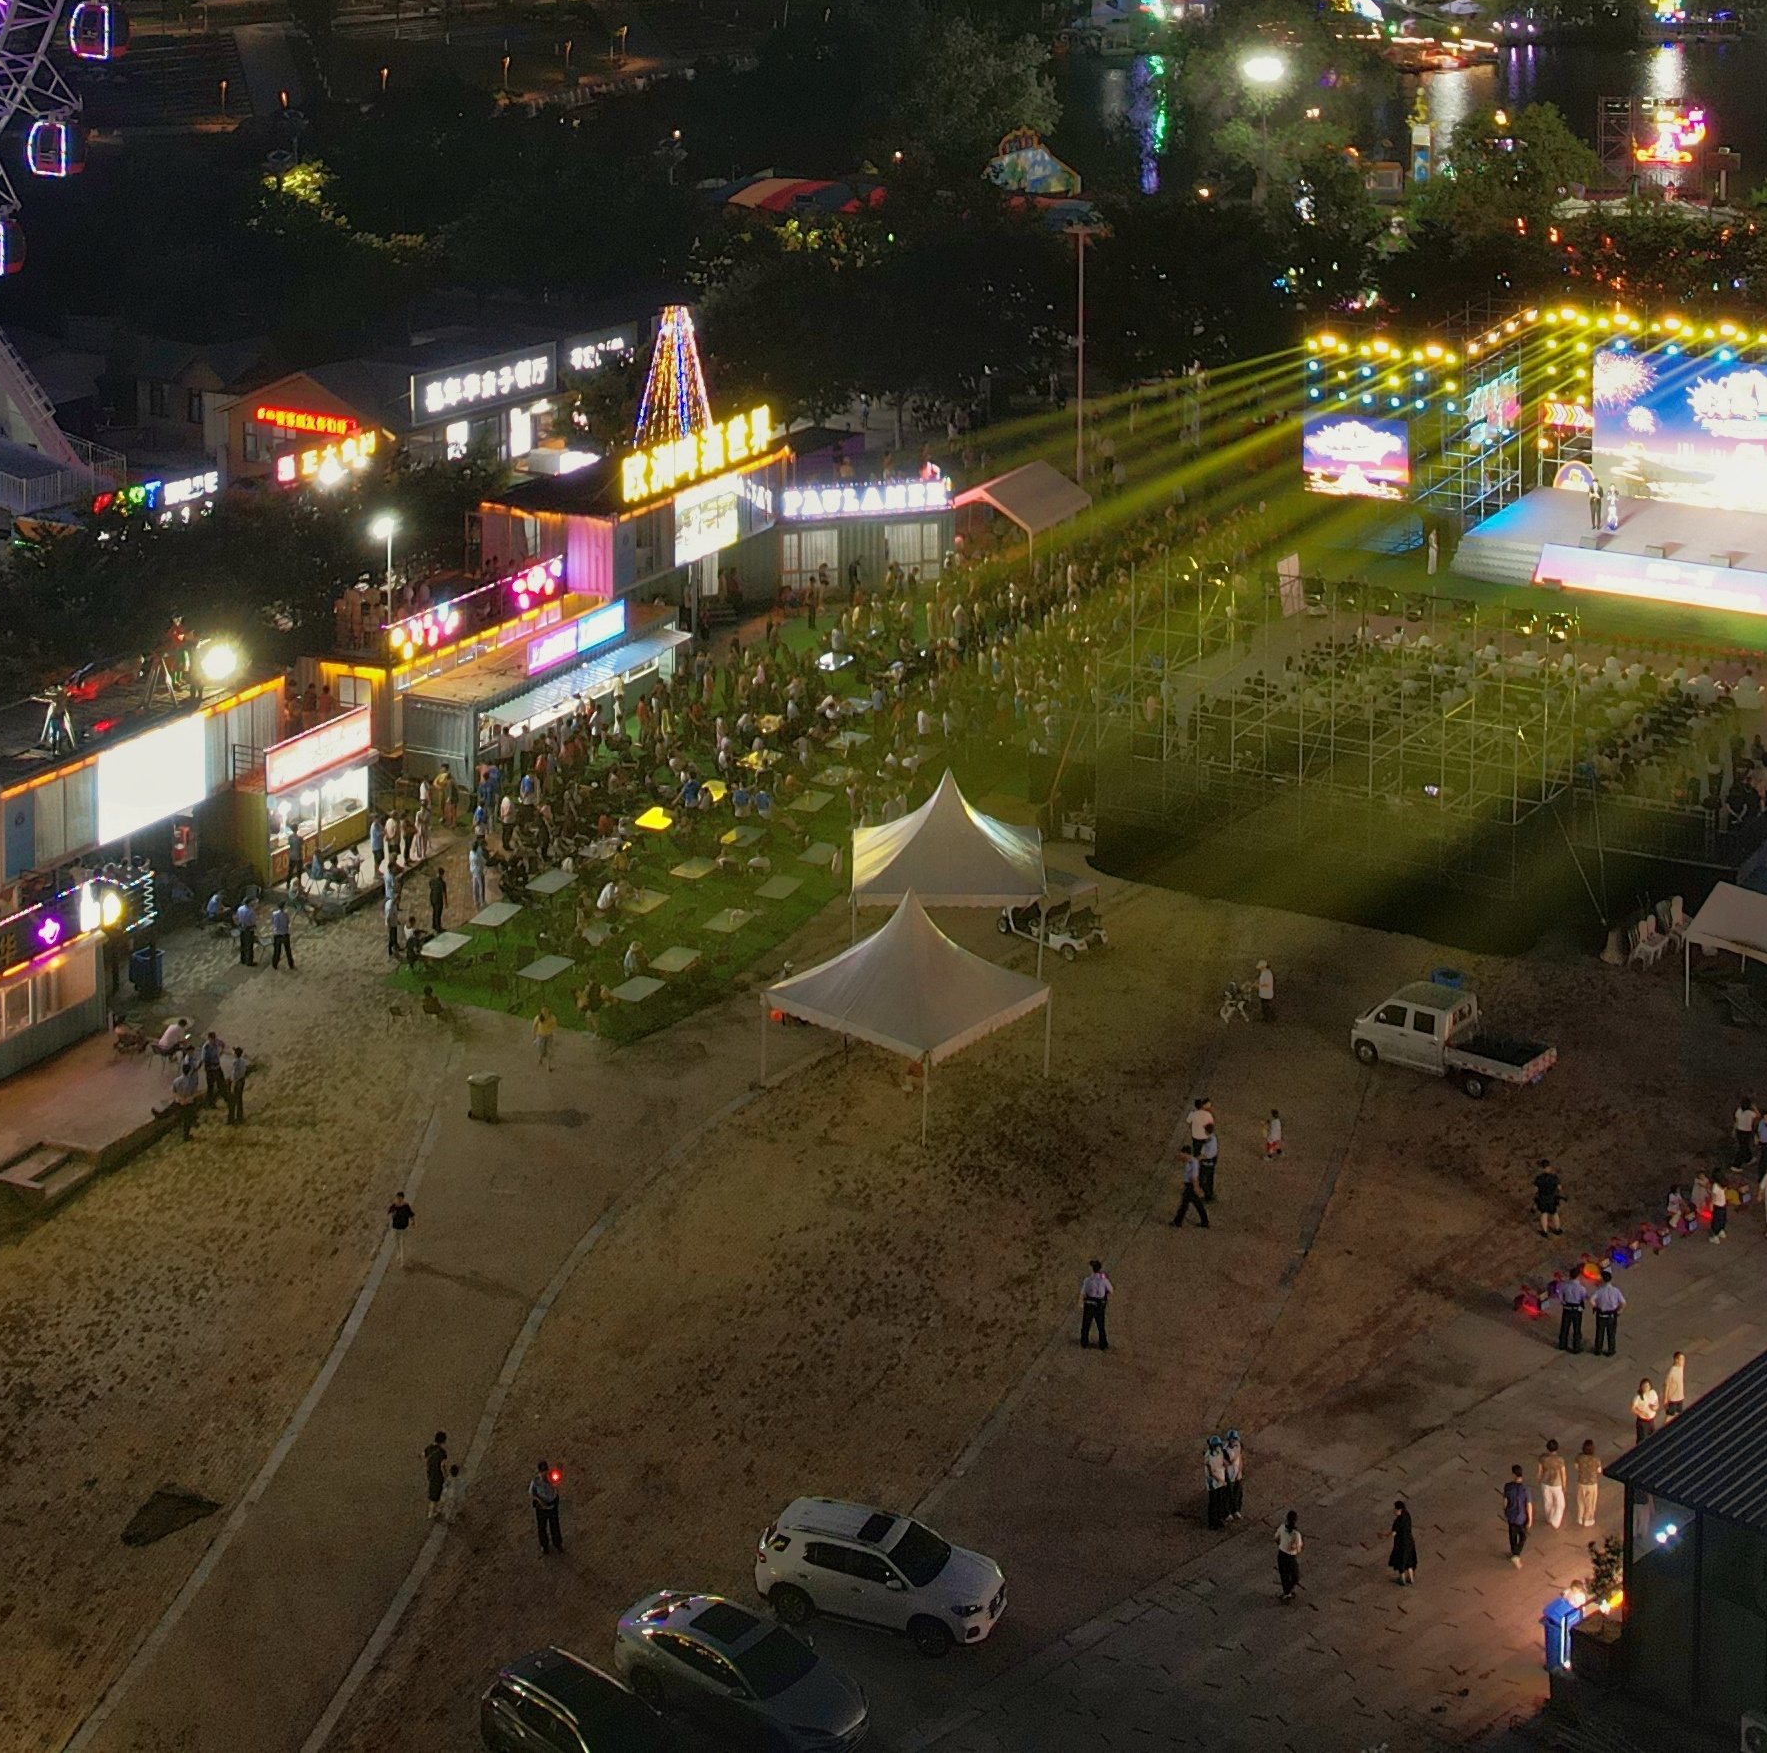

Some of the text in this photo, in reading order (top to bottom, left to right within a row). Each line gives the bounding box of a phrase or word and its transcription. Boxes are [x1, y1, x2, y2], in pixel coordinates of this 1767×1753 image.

[622, 403, 773, 503] 欧洲啤酒世界
[783, 481, 948, 517] PAULANER
